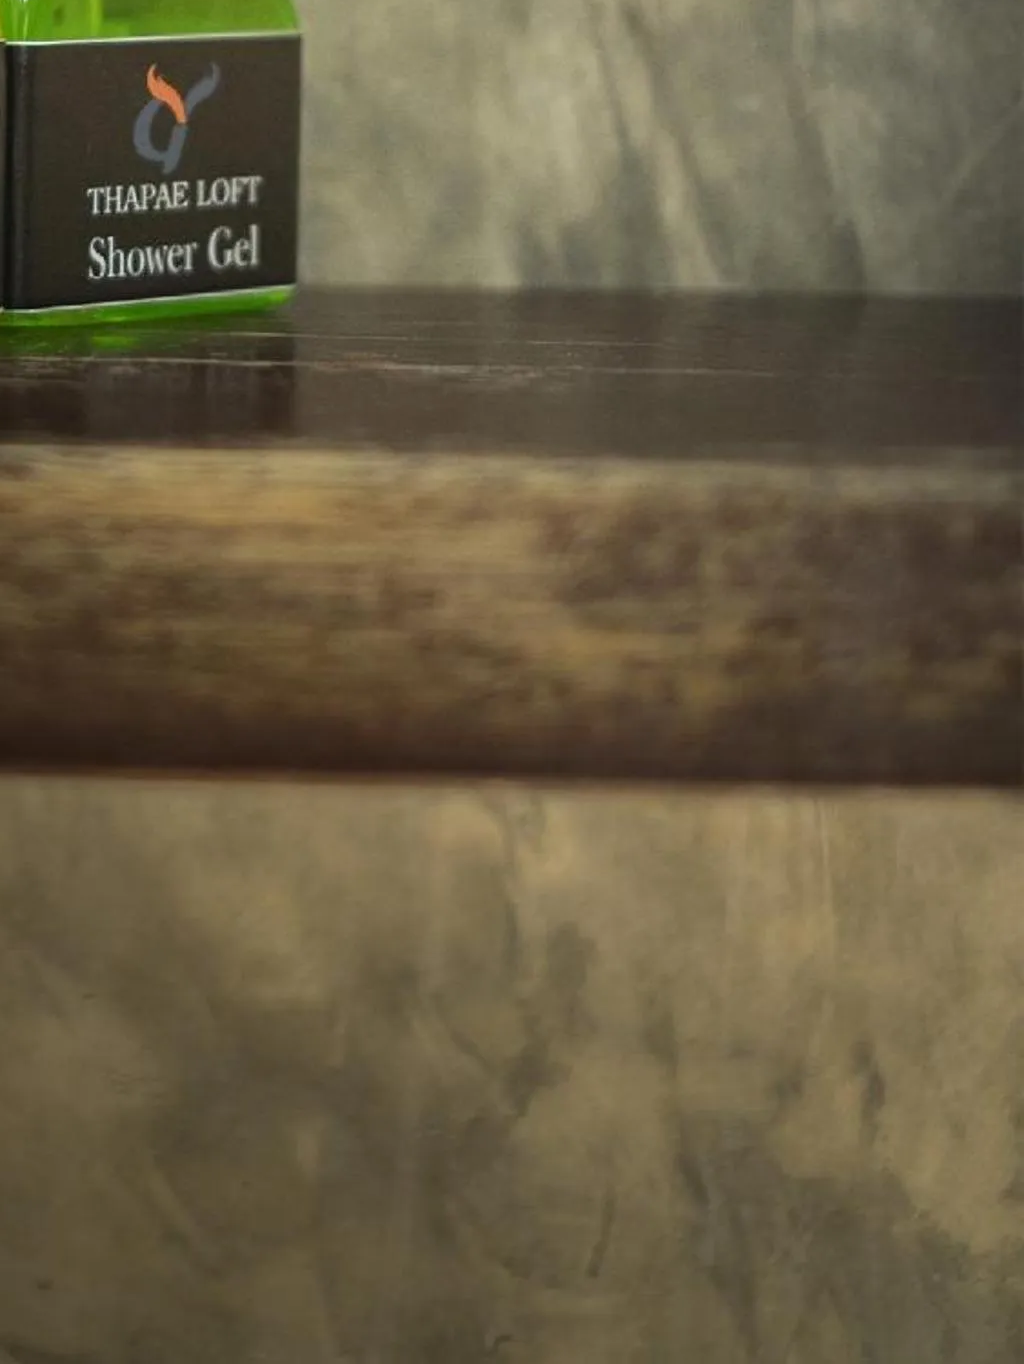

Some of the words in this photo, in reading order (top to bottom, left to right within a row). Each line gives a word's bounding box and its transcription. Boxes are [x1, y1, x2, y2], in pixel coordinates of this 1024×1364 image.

[86, 181, 189, 215] THAPAE
[196, 175, 262, 207] LOFT
[87, 235, 198, 280] Shower
[207, 223, 259, 270] Gel
